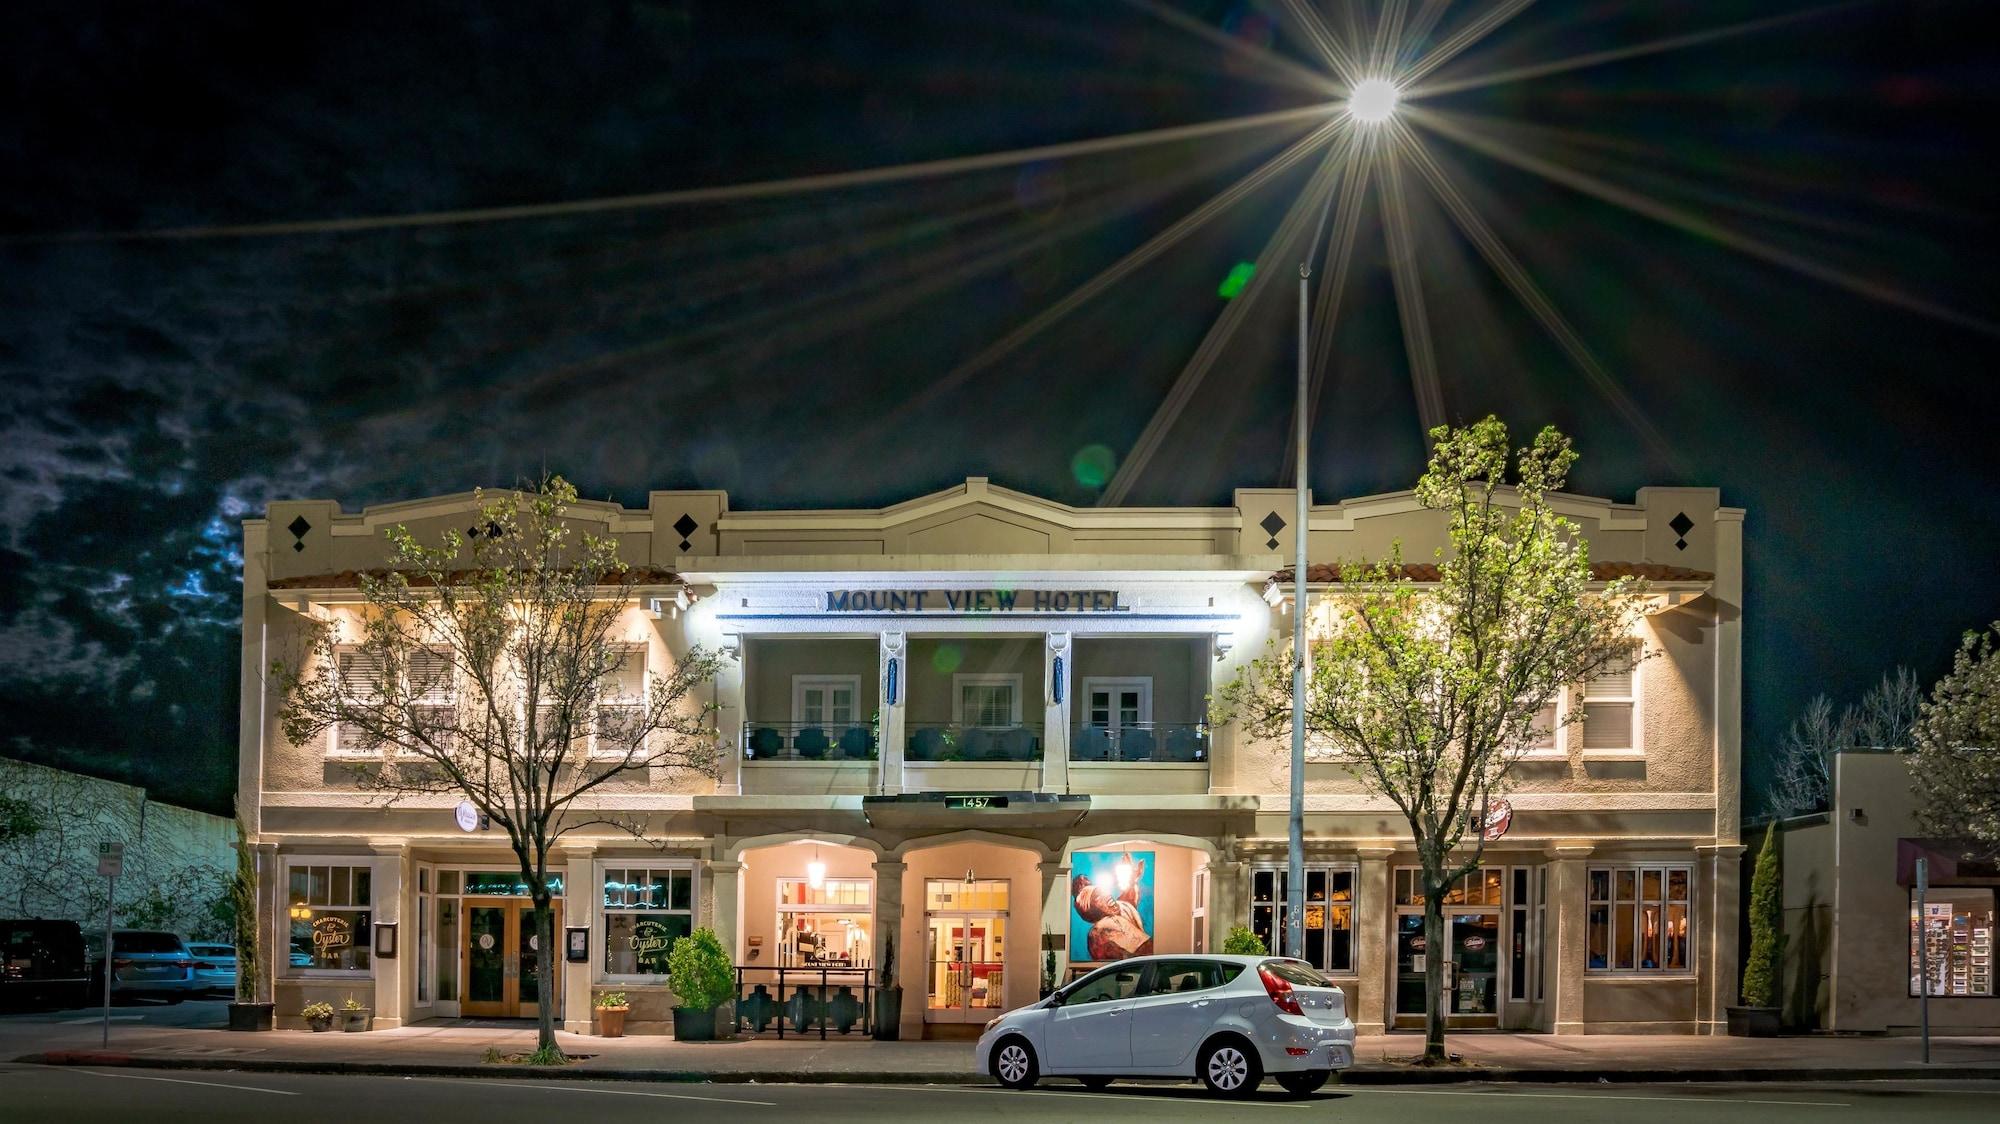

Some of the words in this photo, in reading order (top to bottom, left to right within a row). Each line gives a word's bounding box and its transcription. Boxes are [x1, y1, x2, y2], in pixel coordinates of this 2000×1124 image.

[826, 590, 928, 612] MOUNT
[944, 590, 1018, 612] VIEW
[1033, 590, 1130, 612] HOTEL
[963, 797, 990, 808] 1457
[312, 917, 349, 927] CHARCUTERIE
[313, 930, 350, 951] Oyster
[630, 935, 668, 956] Oyster
[638, 957, 657, 965] BAR
